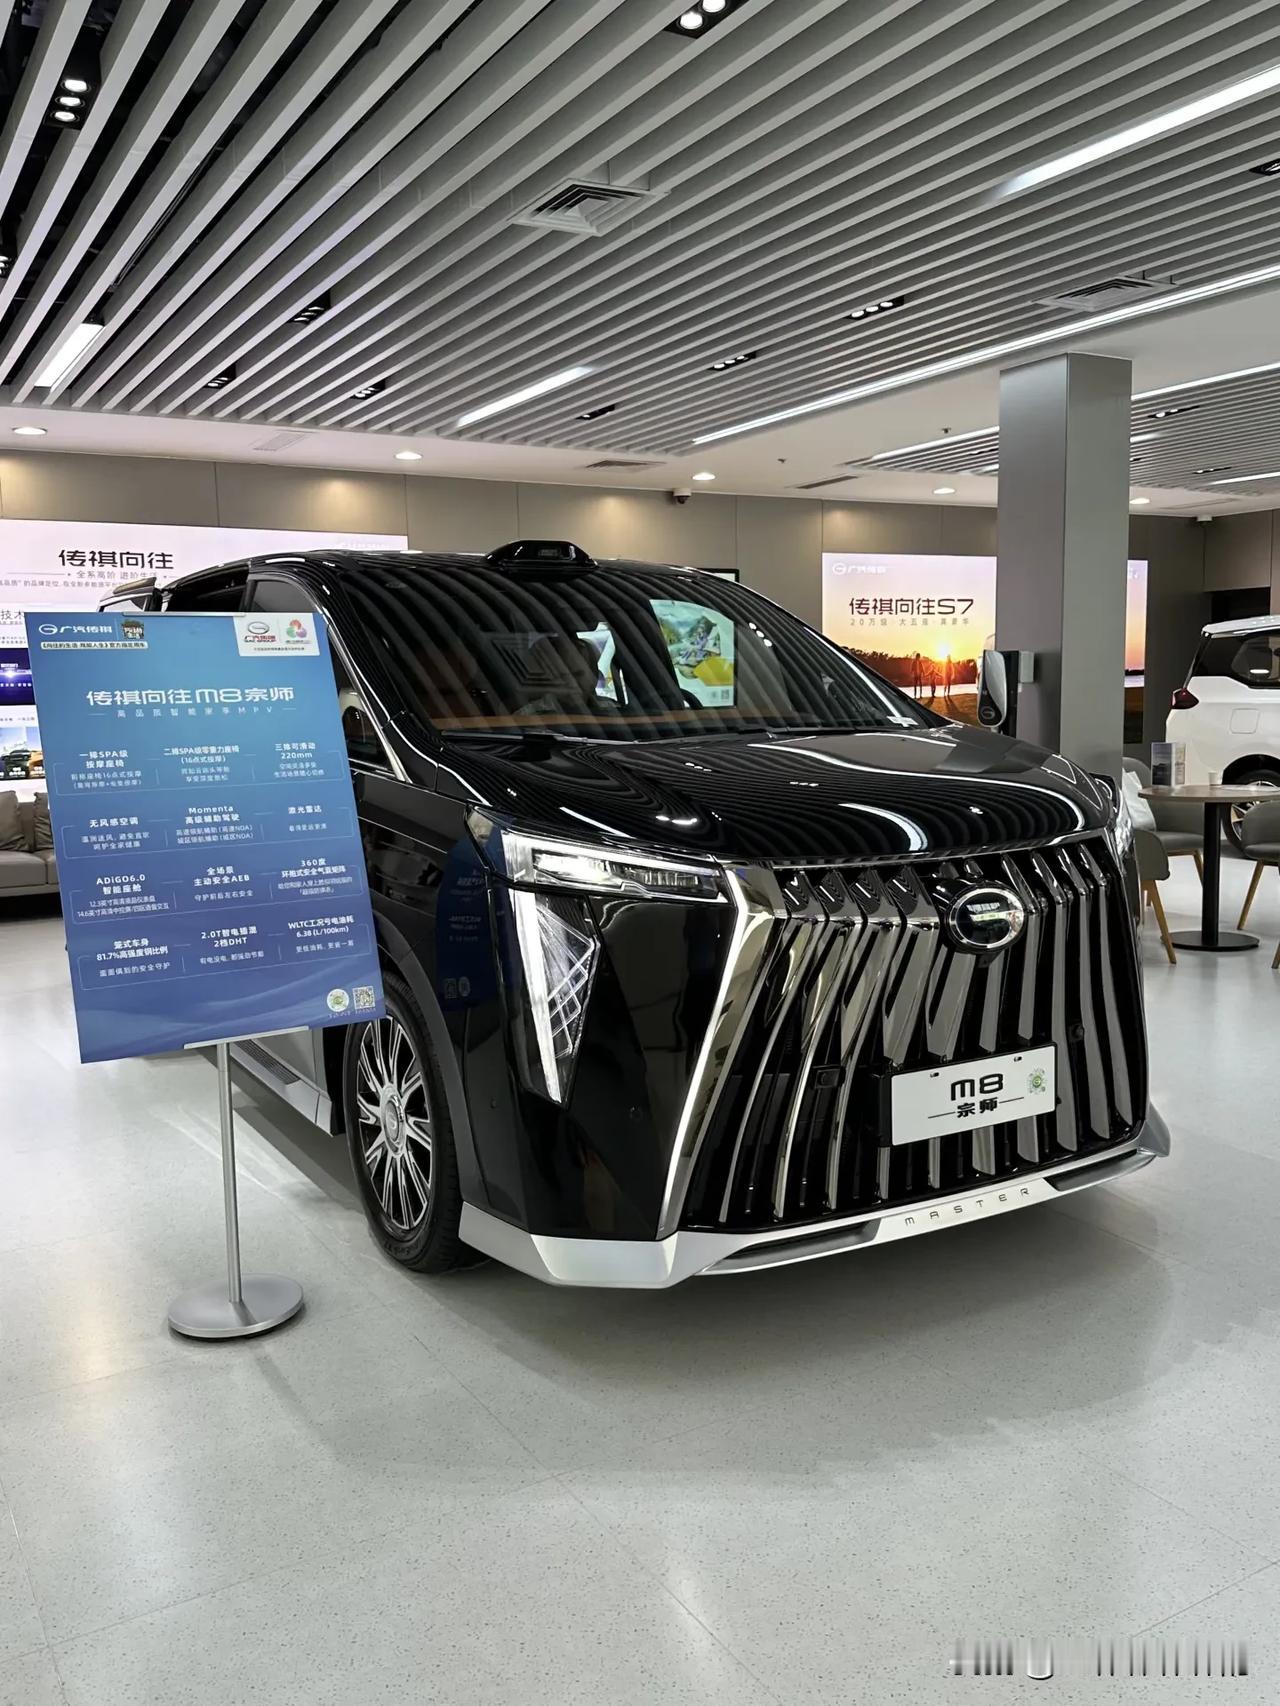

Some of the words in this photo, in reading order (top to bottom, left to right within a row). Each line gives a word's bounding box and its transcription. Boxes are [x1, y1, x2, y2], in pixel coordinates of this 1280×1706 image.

[59, 550, 174, 569] 传祺向往
[849, 597, 974, 615] 传祺向往S7
[87, 687, 294, 706] 传祺向往M8宗师
[275, 742, 316, 751] 三排可滑动
[80, 750, 128, 759] 一排SPA级
[281, 752, 313, 760] 220mm
[86, 759, 124, 769] 按摩座椅
[188, 806, 233, 814] Momenta
[288, 805, 322, 814] 激光雷达
[90, 817, 139, 828] 无风感空调
[185, 813, 240, 824] 高级辅助驾驶
[301, 858, 327, 867] 360度
[207, 866, 234, 875] 全场景
[96, 874, 146, 885] ADiGO6.0
[194, 874, 250, 886] 主动安全AEB
[103, 884, 142, 895] 智能座舱
[214, 937, 247, 948] 2档DHT
[951, 1073, 1003, 1101] M8
[957, 1097, 998, 1118] 宗师
[905, 1188, 1030, 1226] MASTER
